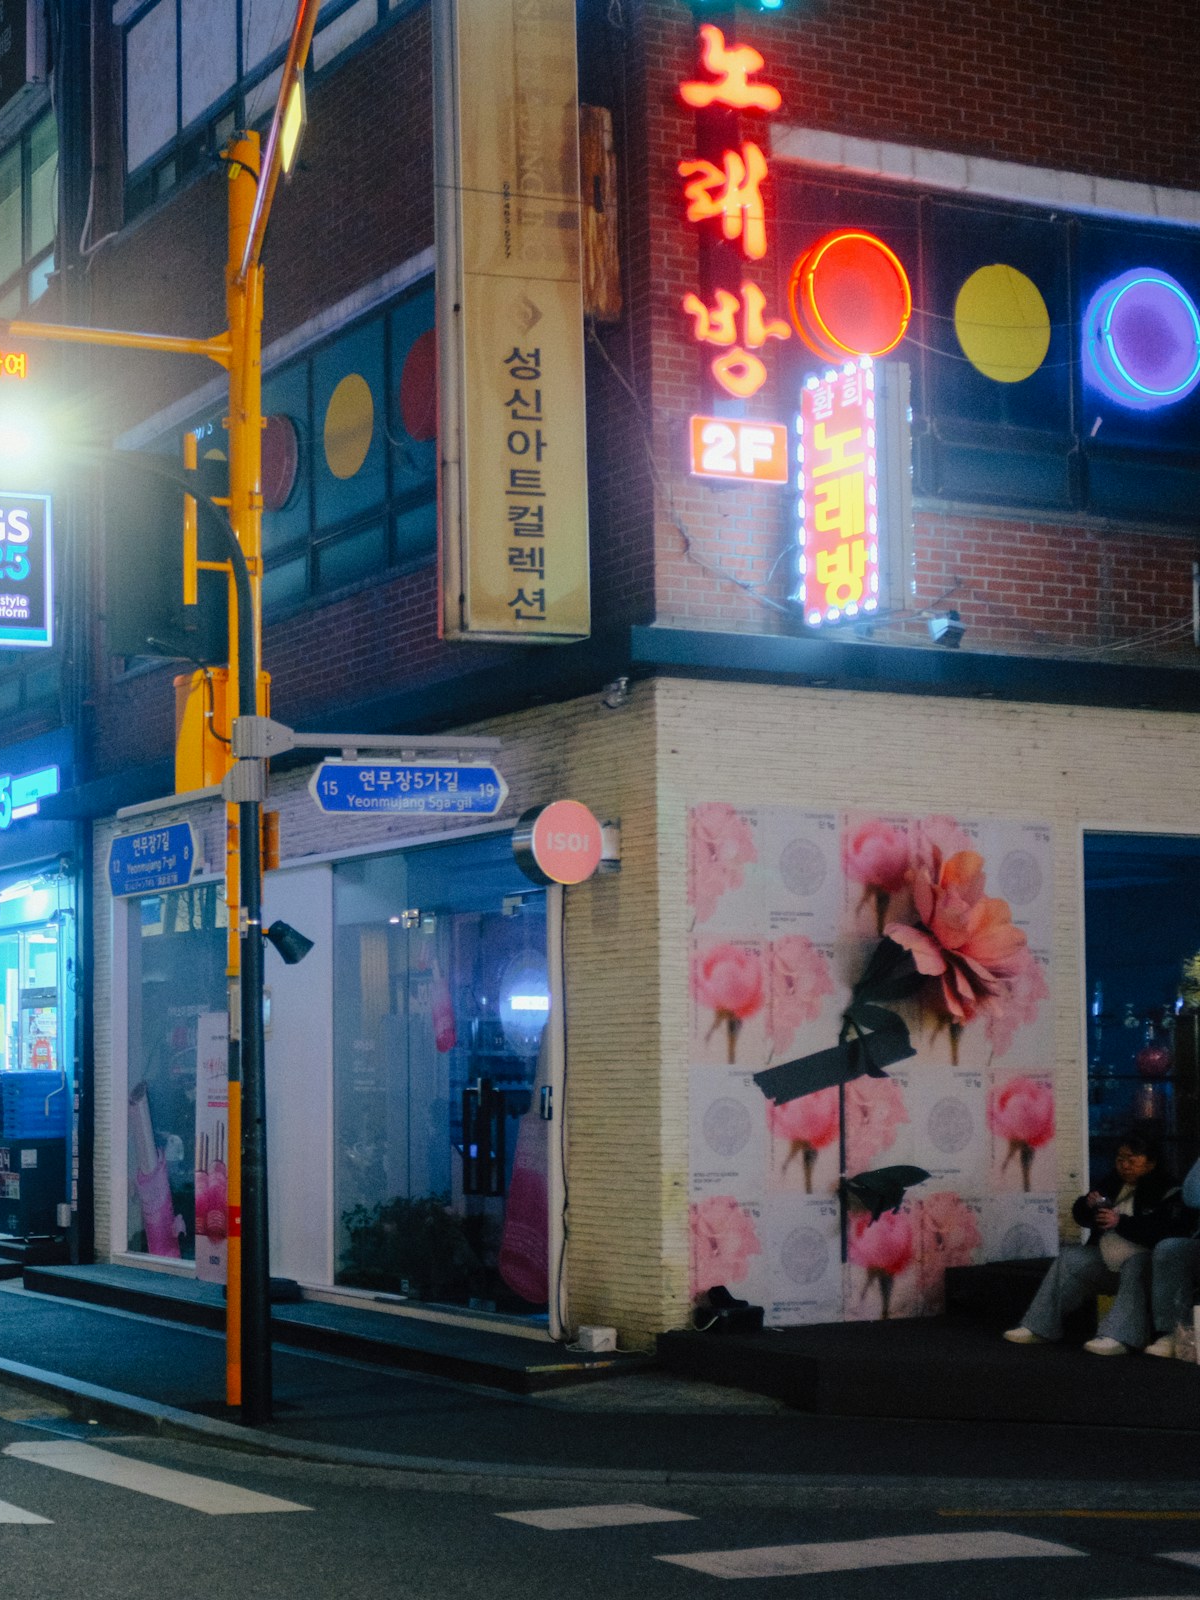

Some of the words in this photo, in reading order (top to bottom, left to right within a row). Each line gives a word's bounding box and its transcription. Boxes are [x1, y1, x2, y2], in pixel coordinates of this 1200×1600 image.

[679, 23, 792, 398] 노래방
[812, 374, 866, 420] 환희
[701, 424, 776, 473] 2F
[504, 347, 548, 623] 성신아트컬렉션
[813, 422, 871, 610] 노래방
[322, 781, 338, 796] 15
[359, 769, 459, 793] 연무장5가길
[479, 783, 495, 797] 19
[347, 794, 425, 812] Yeonmujang
[133, 831, 169, 857] 연무장7길
